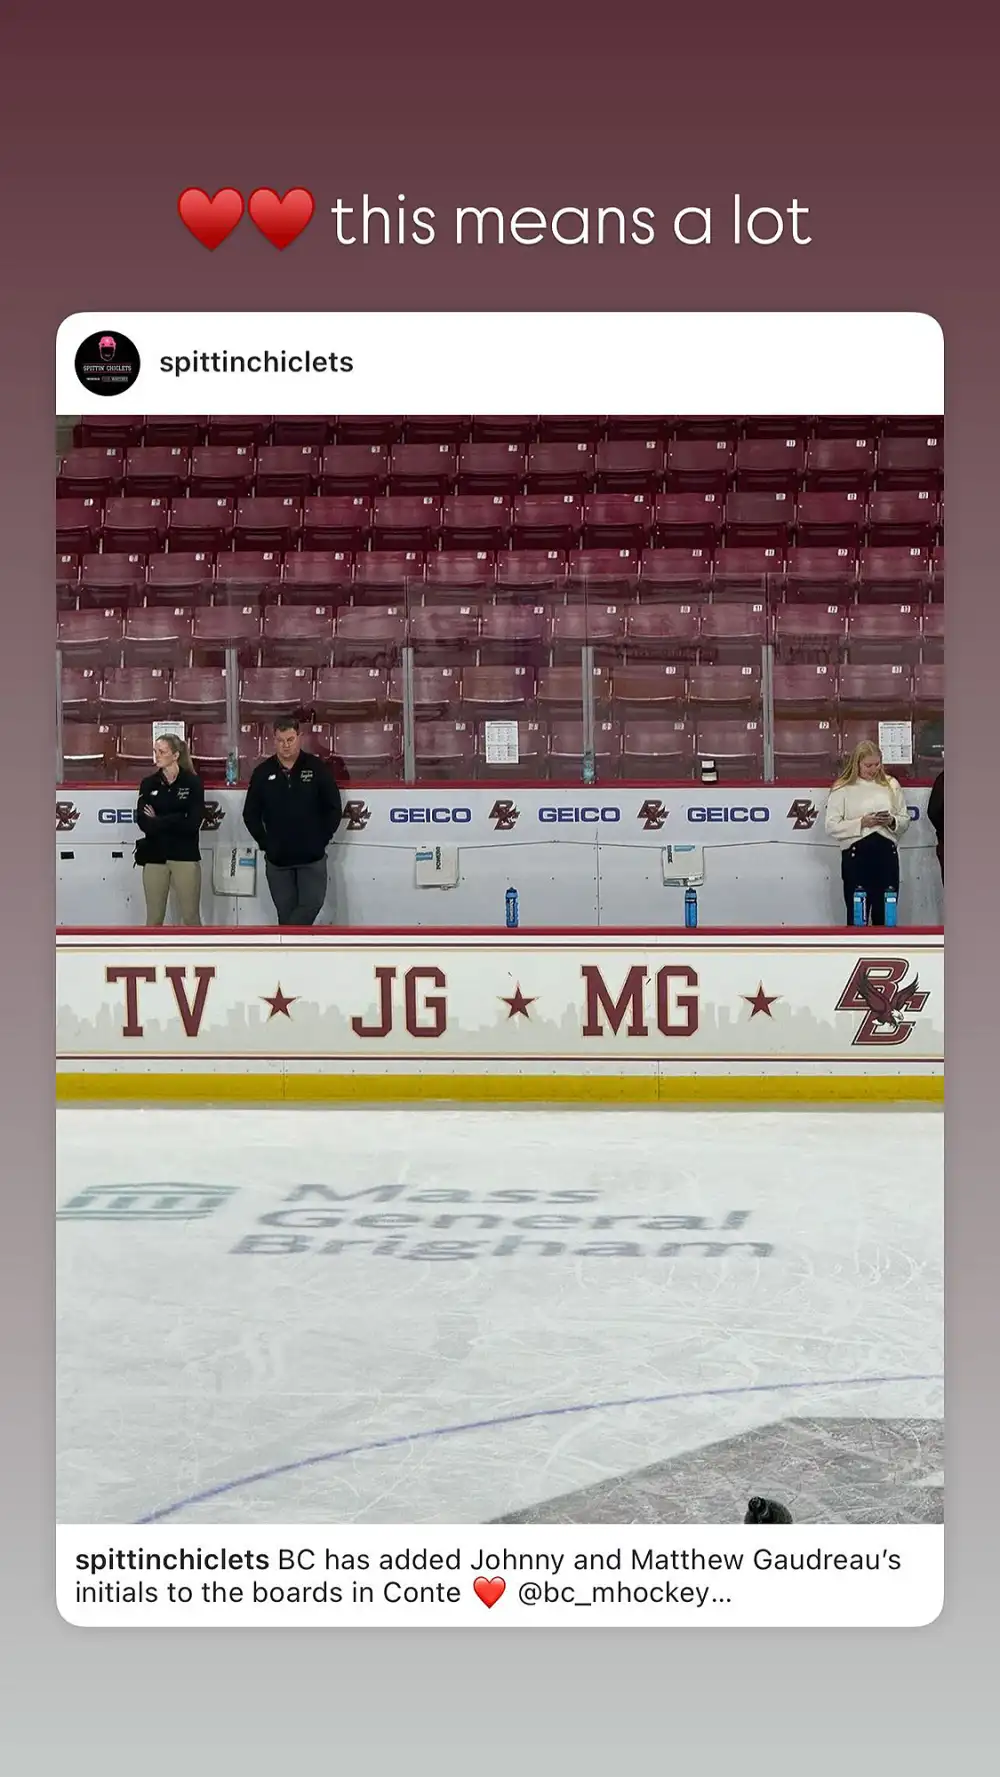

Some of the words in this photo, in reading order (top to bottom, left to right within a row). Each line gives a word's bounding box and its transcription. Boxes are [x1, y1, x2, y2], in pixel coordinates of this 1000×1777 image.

[98, 807, 139, 824] GEI
[389, 807, 472, 824] GEICO
[538, 807, 621, 823] GEICO
[687, 807, 770, 823] GEICO
[106, 966, 216, 1037] TV
[351, 966, 448, 1038] JG
[582, 965, 700, 1037] MG
[283, 1183, 603, 1205] Mass
[259, 1207, 753, 1232] General
[228, 1233, 775, 1262] Brigham
